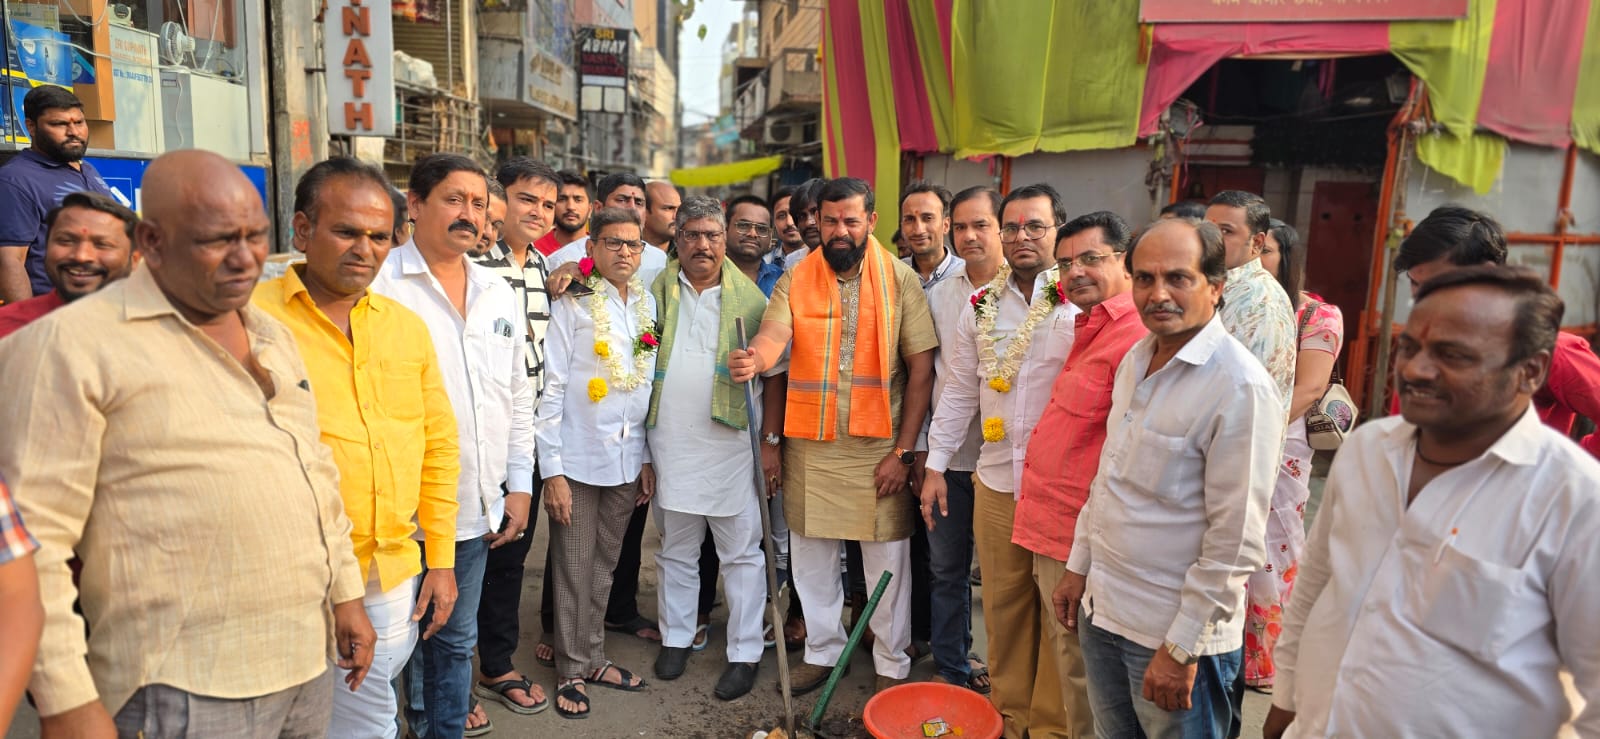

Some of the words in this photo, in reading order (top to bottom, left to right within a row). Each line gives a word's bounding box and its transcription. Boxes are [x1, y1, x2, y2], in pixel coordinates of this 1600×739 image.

[594, 28, 615, 40] SRI
[582, 38, 626, 54] ABHAY
[342, 0, 374, 131] NATH
